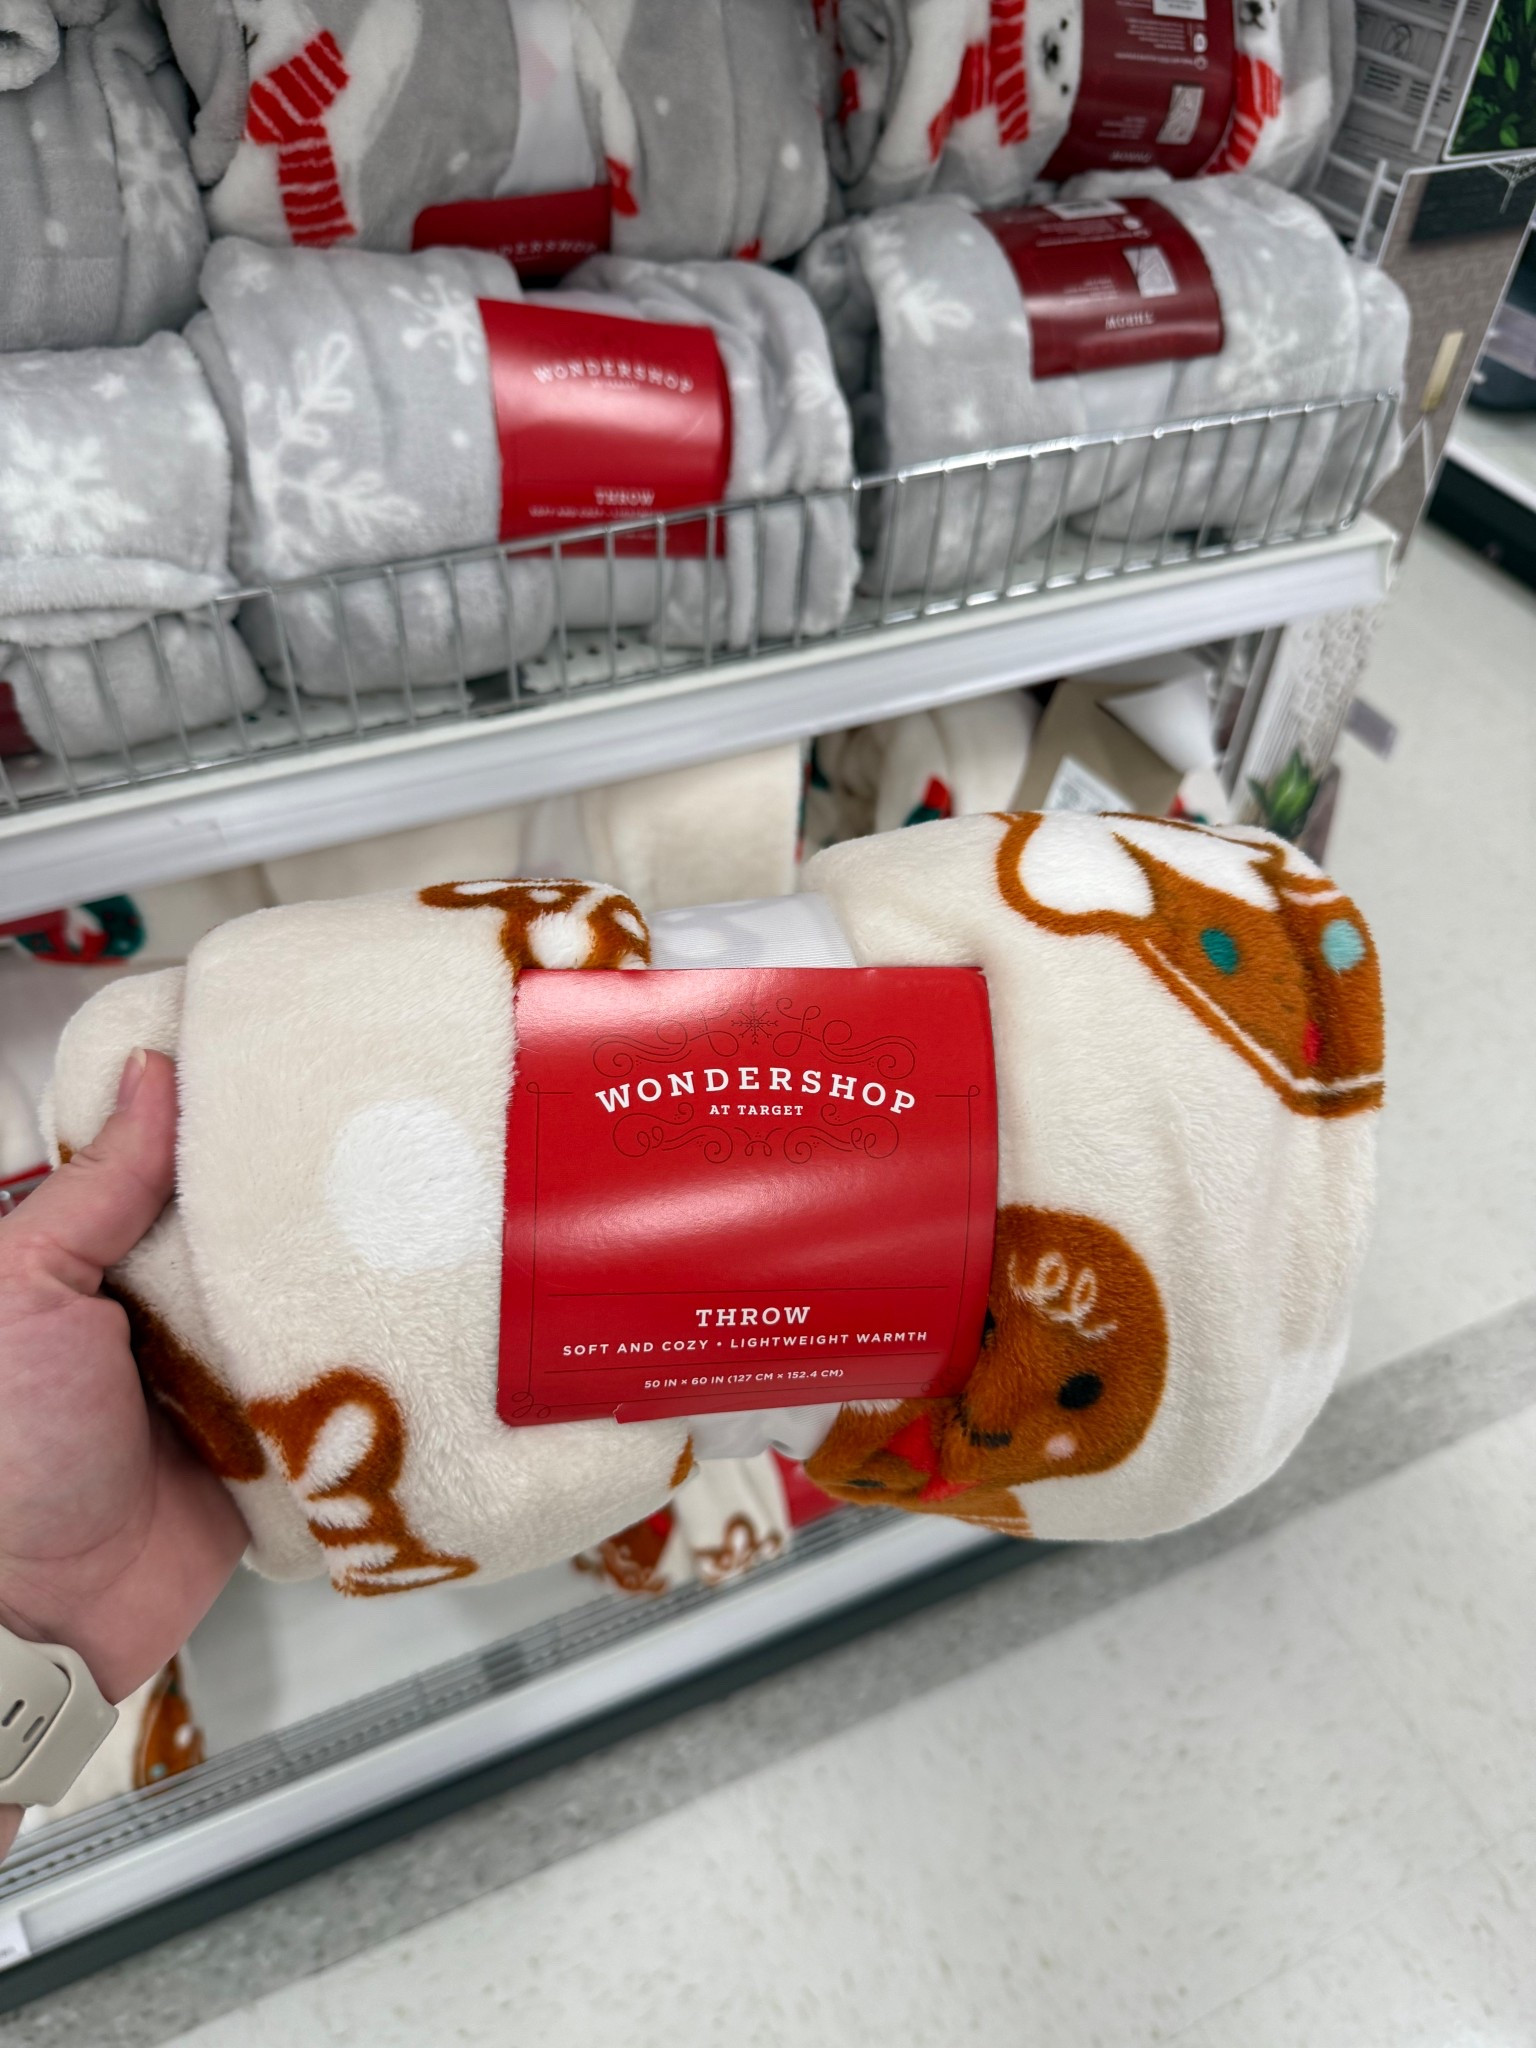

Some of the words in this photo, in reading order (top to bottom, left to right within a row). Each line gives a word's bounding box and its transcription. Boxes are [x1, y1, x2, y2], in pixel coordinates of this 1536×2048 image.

[533, 359, 694, 394] WONDERSHOP
[595, 488, 655, 506] THROW
[595, 1066, 916, 1114] WONDERSHOP
[709, 1104, 731, 1116] AT
[738, 1104, 804, 1117] TARGET
[695, 1306, 811, 1328] THROW
[562, 1343, 610, 1357] SOFT
[616, 1342, 654, 1354] AND
[661, 1339, 709, 1352] COZY
[730, 1334, 849, 1349] LIGHTWEIGHT
[856, 1331, 928, 1344] WARMTH
[644, 1380, 661, 1389] 50
[664, 1378, 678, 1388] IN
[691, 1377, 708, 1386] 60
[711, 1375, 724, 1385] IN
[727, 1373, 752, 1384] (127
[755, 1372, 774, 1382] CM
[787, 1370, 818, 1380] 152.4
[820, 1369, 844, 1379] CM)
